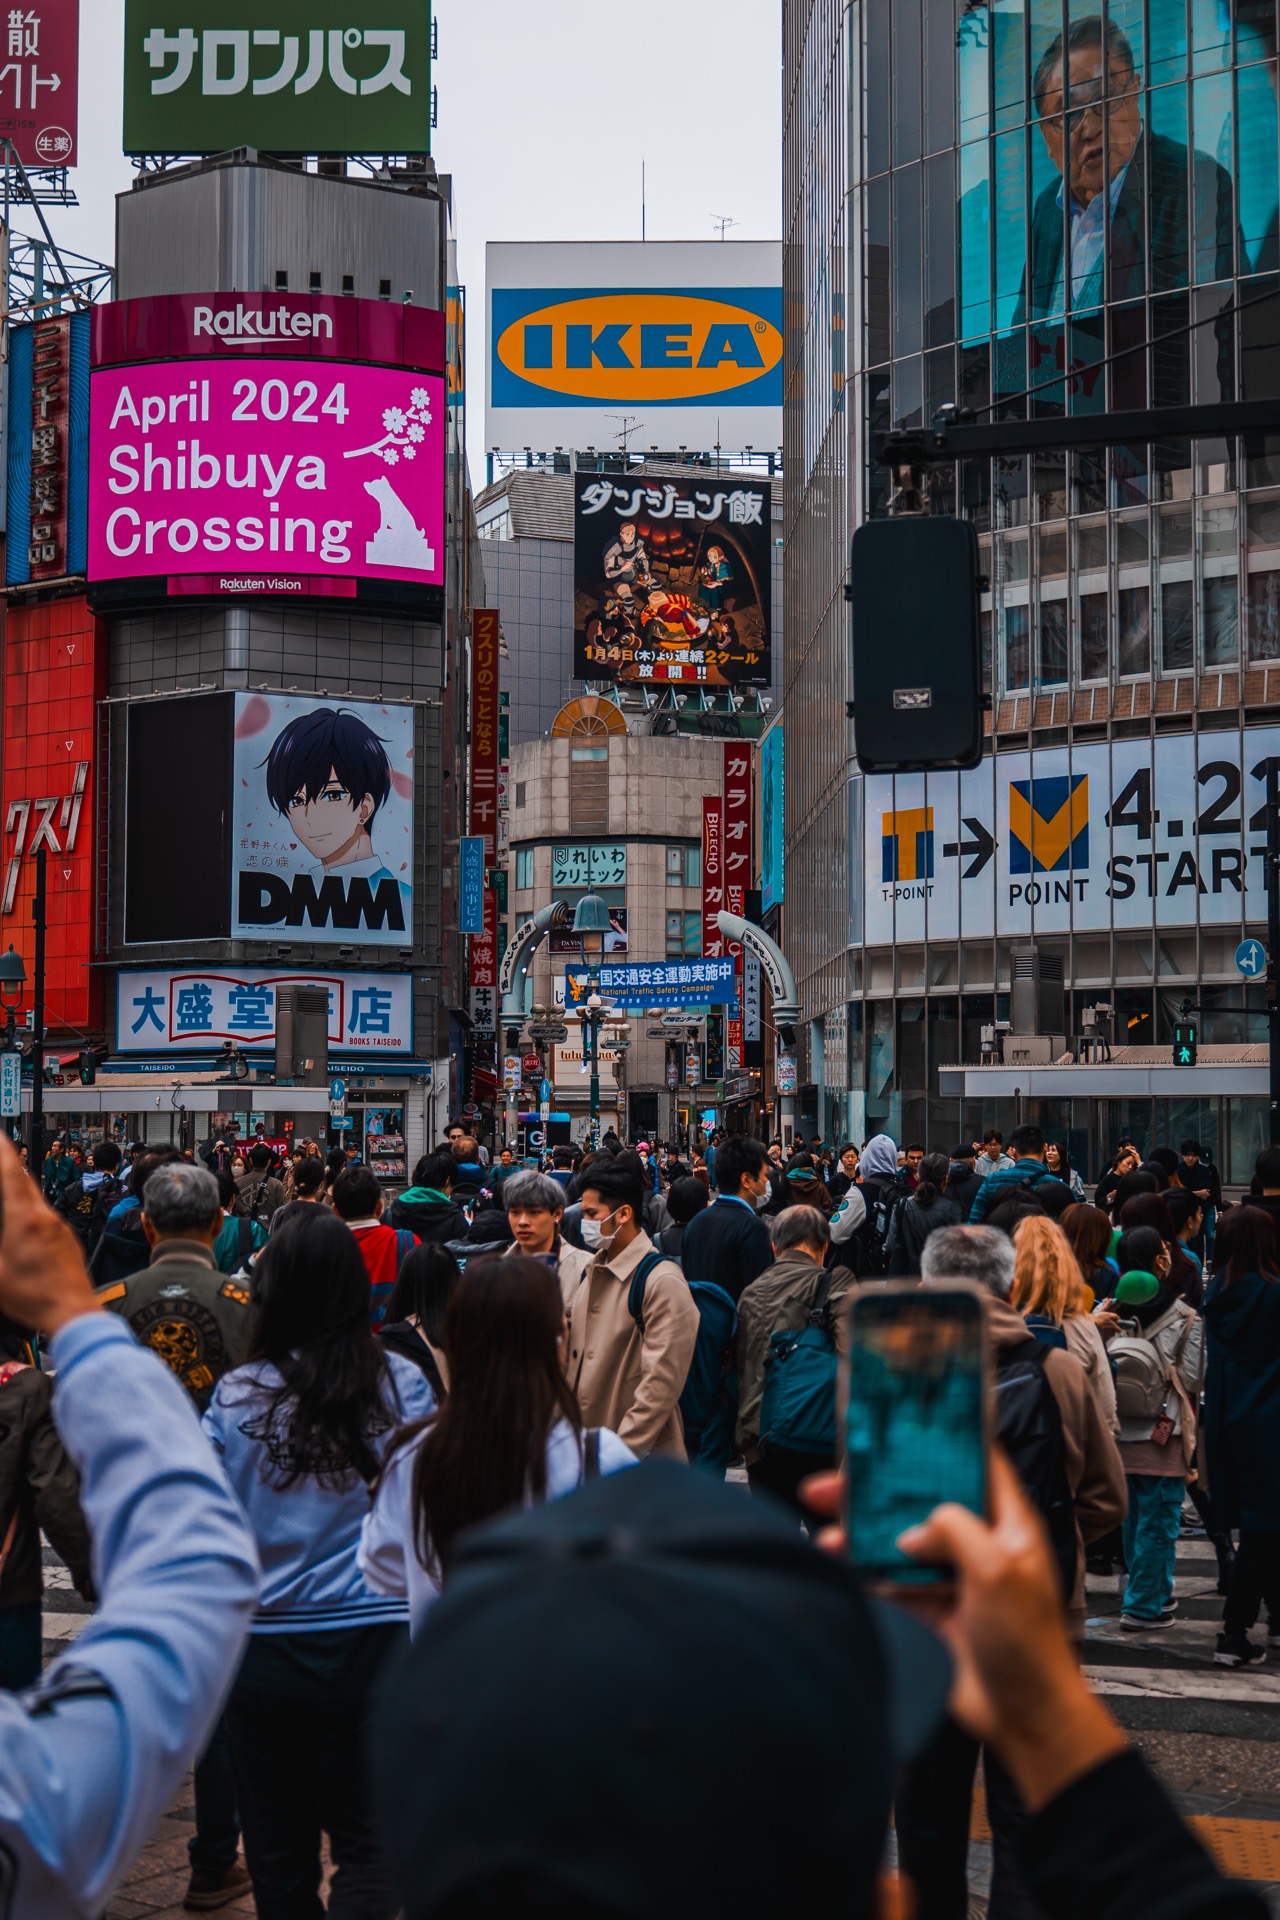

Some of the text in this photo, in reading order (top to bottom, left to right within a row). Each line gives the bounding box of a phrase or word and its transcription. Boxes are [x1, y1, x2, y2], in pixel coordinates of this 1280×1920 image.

[8, 10, 41, 57] 散
[144, 28, 411, 95] サロンパス
[38, 136, 69, 152] 生薬
[194, 304, 333, 340] Rakuten
[524, 323, 766, 369] IKEA
[109, 379, 350, 433] April 2024
[28, 325, 62, 565] 三千里薬品
[108, 439, 327, 498] Shibuya
[581, 480, 763, 526] ダンジョン飯
[106, 502, 353, 563] Crossing
[220, 578, 302, 592] Rakuten Vision
[476, 616, 494, 756] クスリのことなら
[638, 664, 708, 680] 放送開始!!
[725, 758, 749, 871] カラオケ
[246, 855, 289, 868] 恋の病
[573, 848, 625, 864] れいわ
[706, 812, 719, 874] BIG ECHO
[465, 842, 479, 928] 大盛堂商事ビル
[555, 868, 625, 884] クリニック
[882, 885, 934, 902] T-POINT
[1010, 878, 1090, 906] POINT
[239, 870, 406, 931] DMM
[705, 886, 723, 957] カラオ
[501, 923, 532, 992] 渋谷センター街
[596, 962, 732, 987] 国交通安全運動実施中
[746, 933, 781, 996] 渋谷センター街
[131, 982, 394, 1034] 大盛堂店
[474, 988, 493, 1025] 牛繁
[656, 986, 679, 995] Safety
[681, 985, 714, 993] Campaign
[747, 963, 757, 1037] 山下本気うどん
[349, 1037, 401, 1046] BOOKS TAISEIDO
[4, 1058, 13, 1107] 文化村通り
